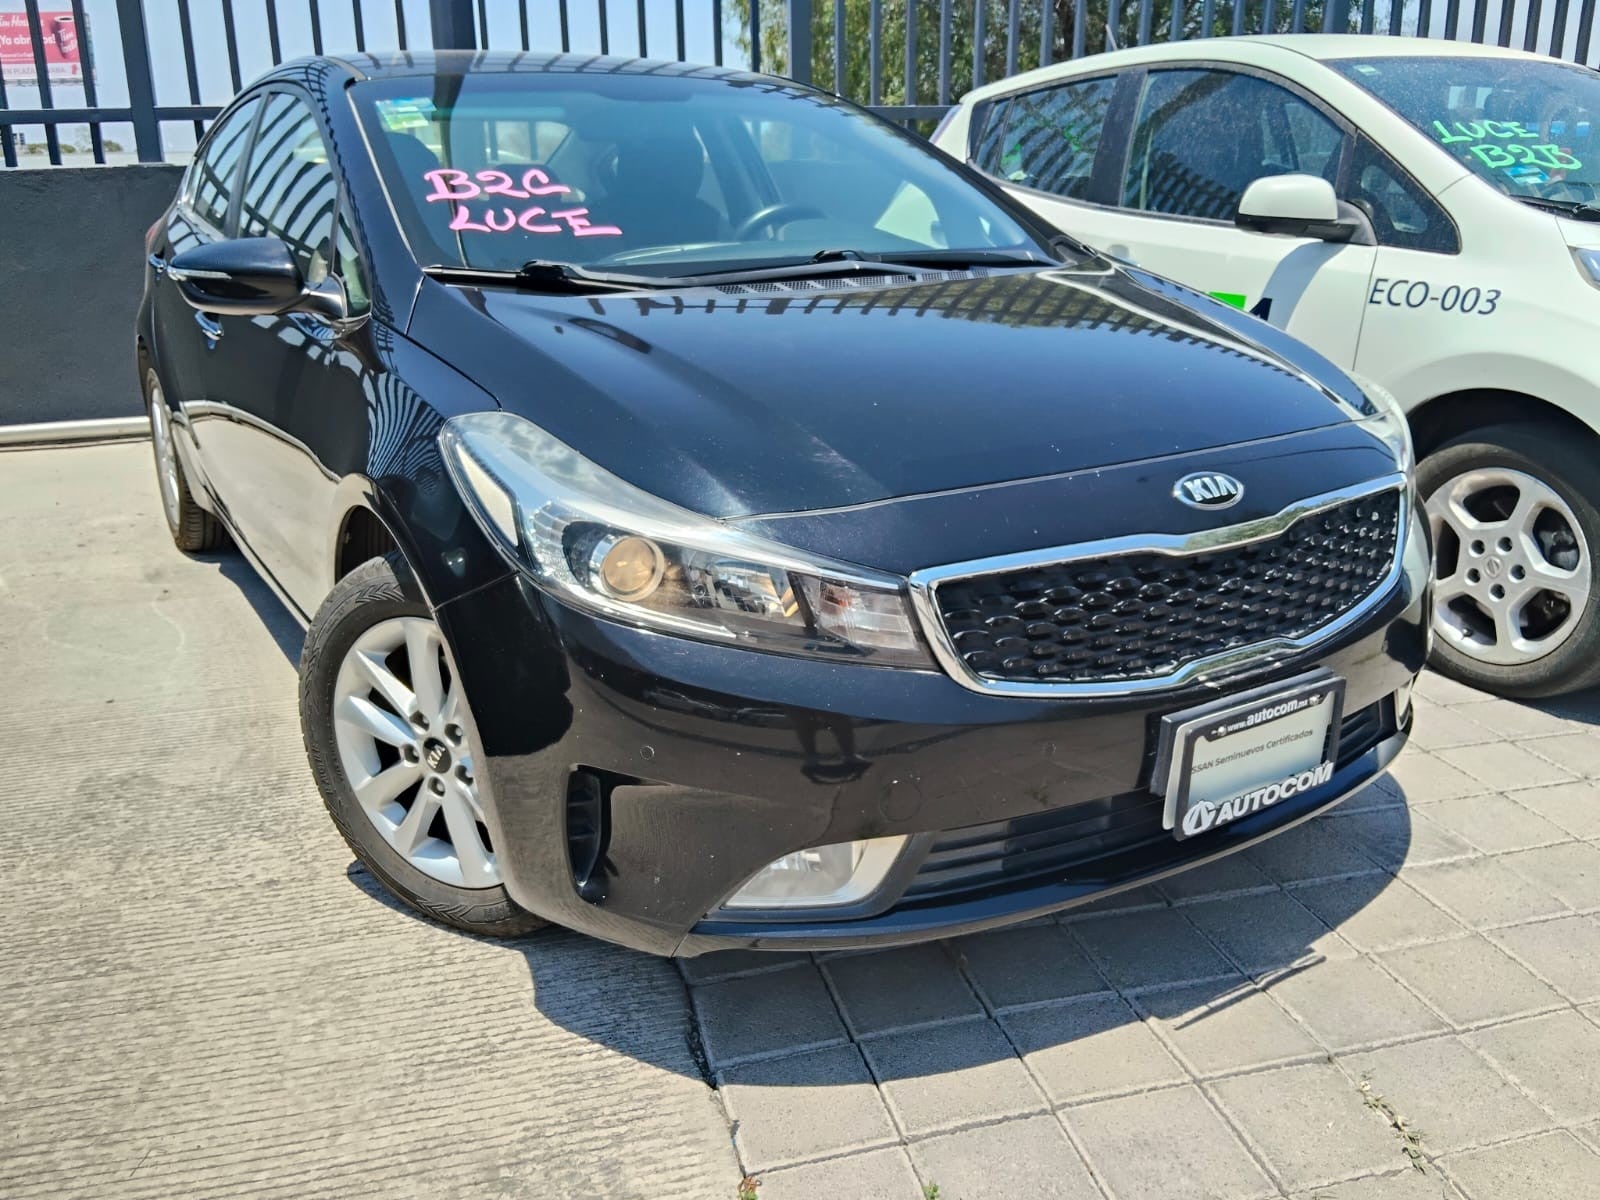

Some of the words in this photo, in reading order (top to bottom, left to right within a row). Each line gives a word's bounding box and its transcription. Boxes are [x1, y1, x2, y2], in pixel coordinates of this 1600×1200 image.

[14, 33, 56, 45] abros!
[1433, 120, 1539, 143] LUCE
[1470, 144, 1582, 169] B2B
[424, 169, 571, 202] B2C
[449, 205, 623, 236] LUCE
[1369, 278, 1502, 315] ECO-003
[1184, 475, 1237, 502] KIA
[427, 743, 446, 769] KIA
[1215, 743, 1265, 766] Seminuevos
[1266, 729, 1314, 749] Certificados
[1215, 761, 1335, 825] AUTOCOM
